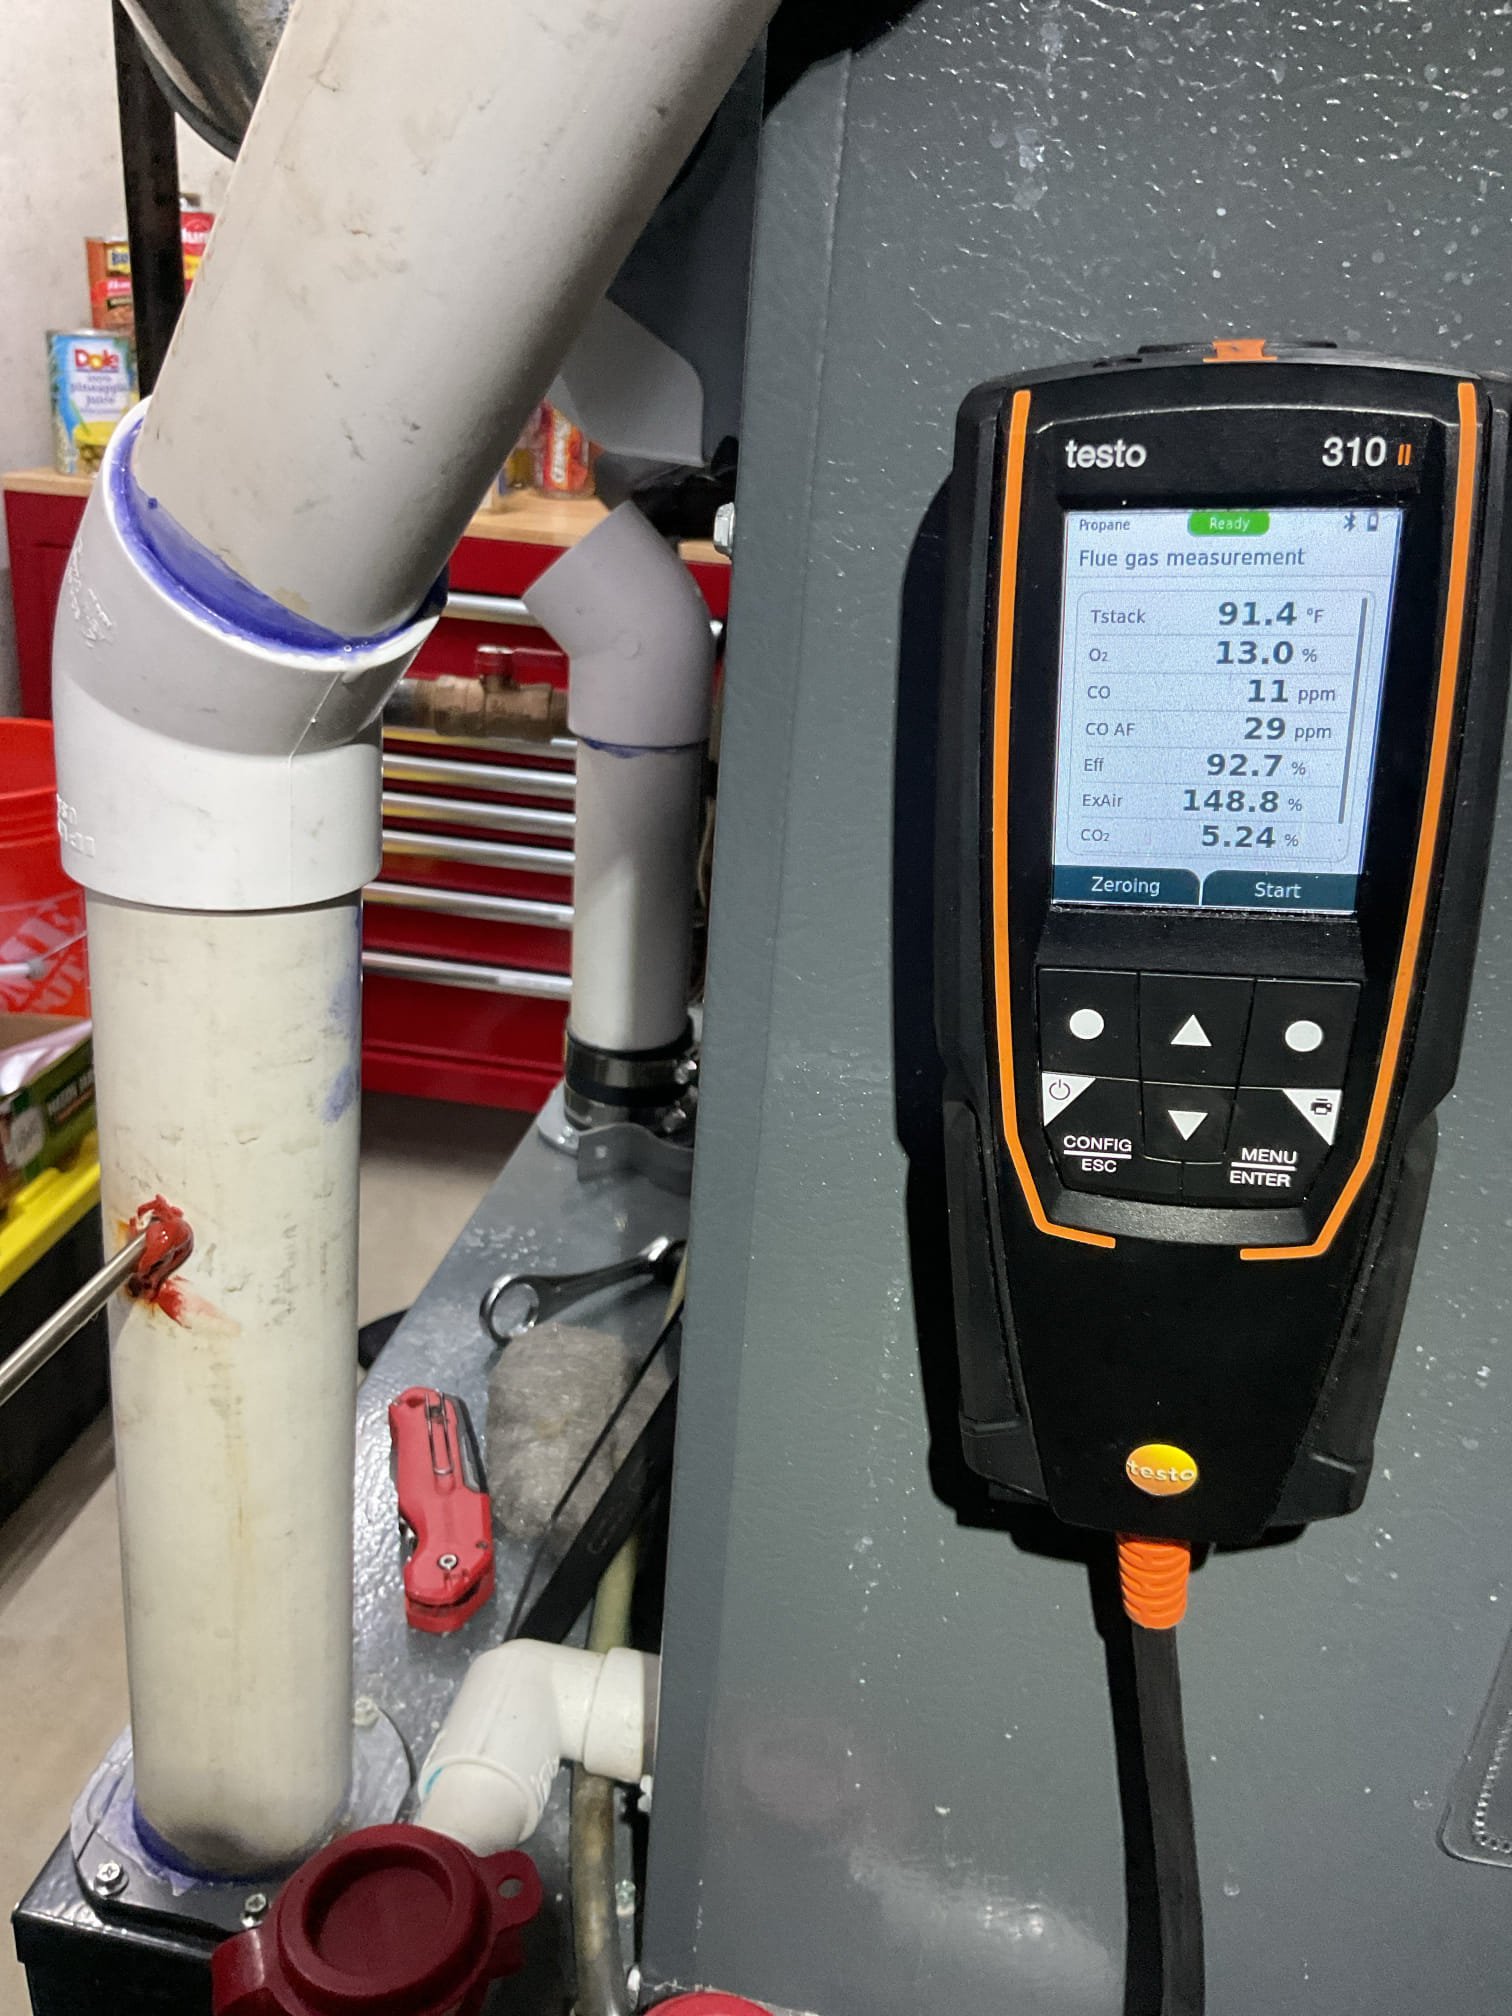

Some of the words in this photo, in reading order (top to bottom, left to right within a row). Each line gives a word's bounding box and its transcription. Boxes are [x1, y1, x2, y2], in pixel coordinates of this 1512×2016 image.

[75, 348, 119, 371] Dole
[1065, 439, 1147, 468] testo
[1322, 436, 1387, 467] 310
[1079, 519, 1130, 532] Propane
[1209, 517, 1250, 531] Ready
[1079, 550, 1118, 567] Flue
[1125, 553, 1159, 570] gas
[1167, 549, 1305, 567] measurement
[1091, 609, 1146, 624] Tstack
[1218, 602, 1297, 626] 91.4
[1216, 640, 1294, 665] 13.0
[1302, 649, 1317, 663] %
[1087, 686, 1111, 699] CO
[1248, 679, 1288, 702] 11
[1299, 689, 1336, 704] ppm
[1086, 722, 1109, 736] CO
[1114, 722, 1135, 736] AF
[1244, 717, 1286, 740] 29
[1294, 727, 1332, 743] ppm
[1084, 758, 1104, 772] Eff
[1206, 753, 1283, 777] 92.7
[1291, 762, 1306, 776] %
[1082, 794, 1123, 808] ExAir
[1183, 789, 1280, 813] 148.8
[1288, 798, 1302, 812] %
[1202, 825, 1276, 848] 5.24
[1284, 834, 1299, 847] %
[1091, 876, 1161, 896] Zeroing
[1254, 881, 1302, 899] Start
[1063, 1135, 1132, 1152] CONFIG
[1081, 1158, 1117, 1173] ESC
[1241, 1148, 1297, 1165] MENU
[1229, 1170, 1291, 1188] ENTER
[1127, 1459, 1195, 1481] testo
